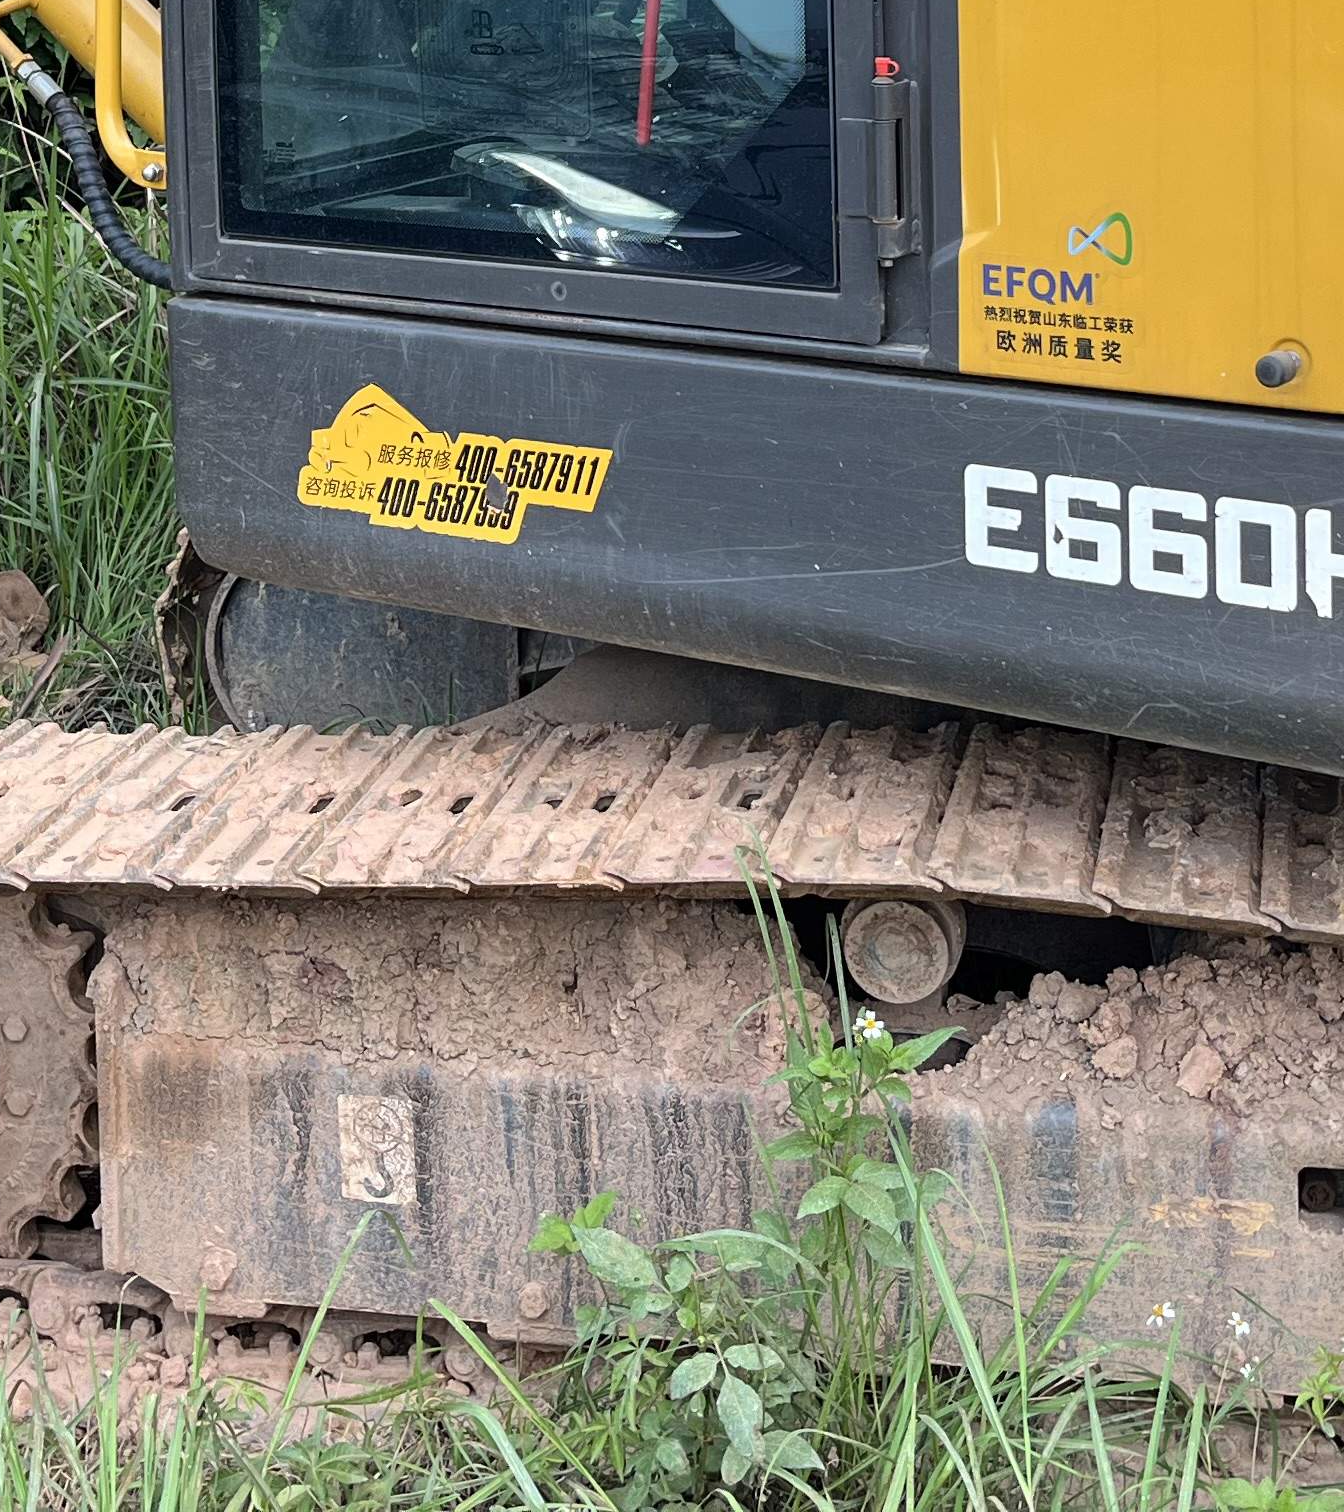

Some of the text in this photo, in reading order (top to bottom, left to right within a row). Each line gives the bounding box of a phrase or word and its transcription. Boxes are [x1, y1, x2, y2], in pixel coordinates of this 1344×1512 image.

[983, 264, 1094, 305] EFQM
[984, 306, 1134, 334] 热烈祝贺山东临工荣获
[996, 330, 1122, 363] 欧洲质量奖
[378, 444, 601, 497] 服务报修 400-6587911
[306, 476, 377, 501] 咨询投诉
